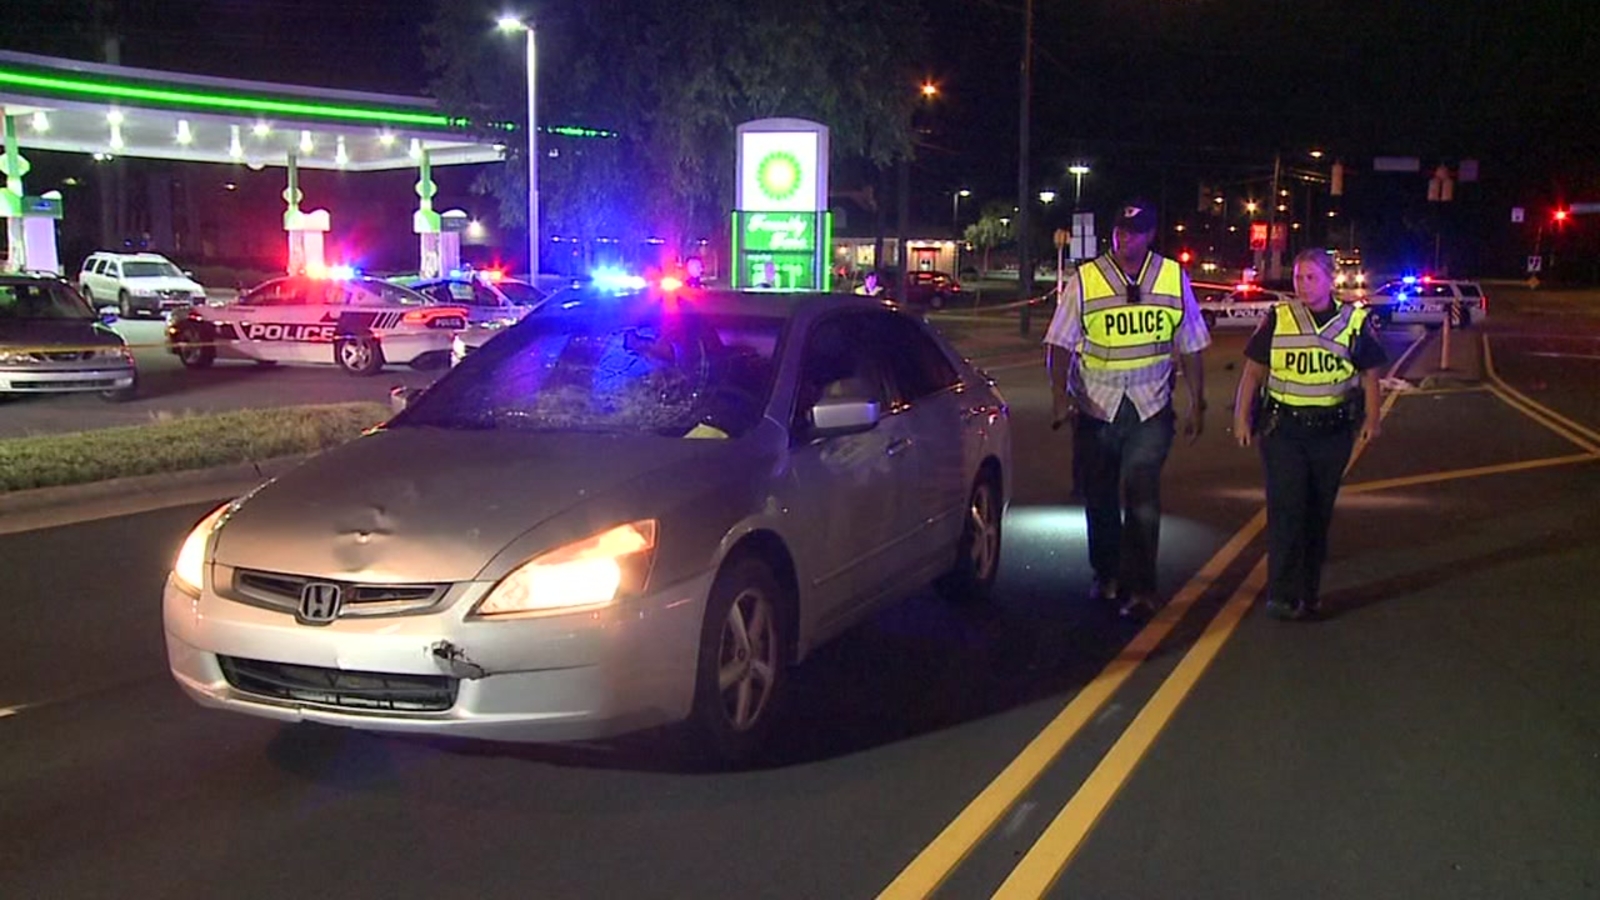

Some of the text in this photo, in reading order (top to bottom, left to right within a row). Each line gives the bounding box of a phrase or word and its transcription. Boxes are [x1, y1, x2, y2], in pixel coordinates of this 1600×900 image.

[249, 325, 336, 342] POLICE
[1105, 310, 1164, 336] POLICE
[1285, 351, 1345, 375] POLICE
